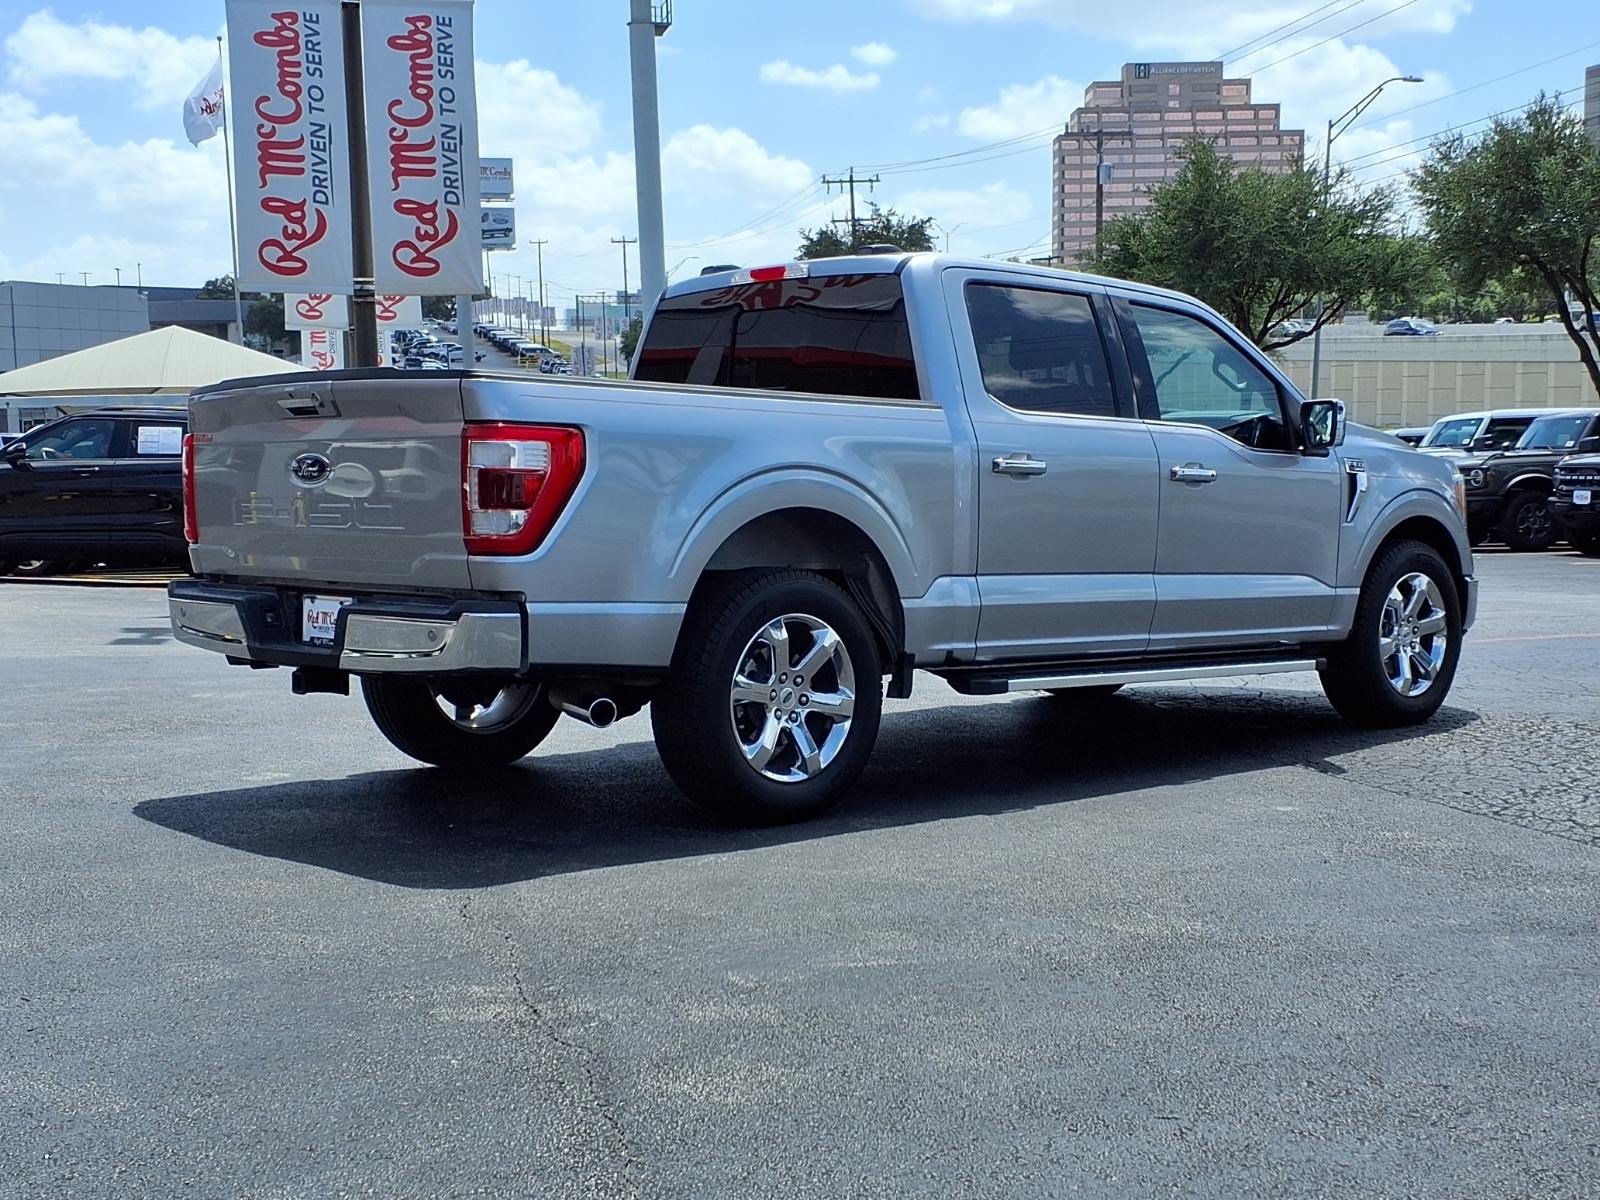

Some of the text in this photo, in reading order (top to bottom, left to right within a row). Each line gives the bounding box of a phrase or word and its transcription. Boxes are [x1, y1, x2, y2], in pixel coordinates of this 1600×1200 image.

[302, 11, 330, 206] DRIVEN TO SERVE
[435, 15, 460, 206] DRIVEN TO SERVE
[253, 11, 328, 276] Red McCombs
[386, 15, 459, 277] Red McCombs
[295, 292, 333, 320] Re
[376, 295, 407, 321] Re
[328, 330, 337, 354] DRIVE
[377, 330, 385, 354] DRIVE
[298, 459, 320, 477] Ford
